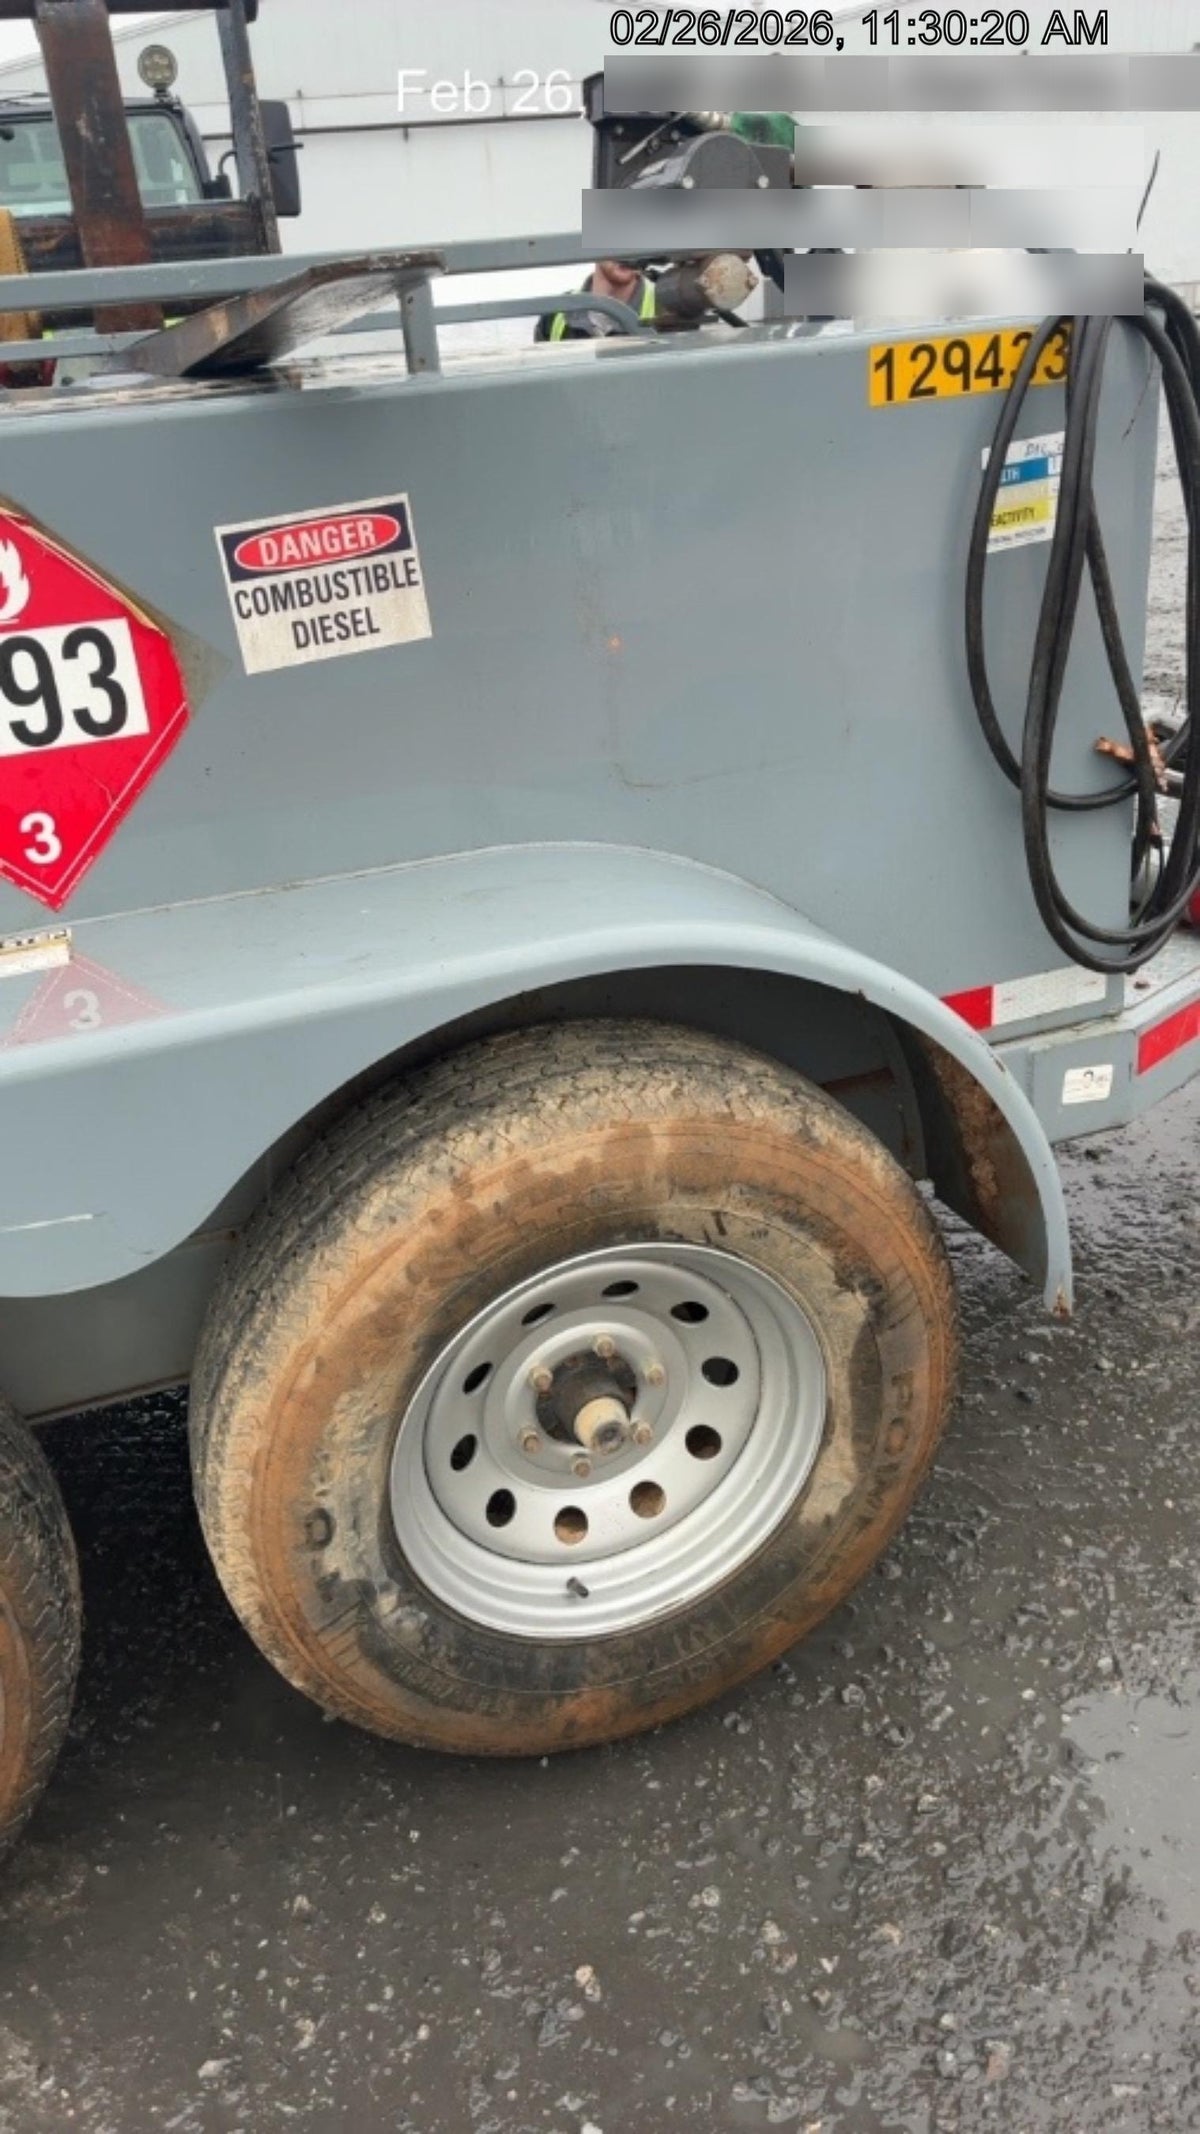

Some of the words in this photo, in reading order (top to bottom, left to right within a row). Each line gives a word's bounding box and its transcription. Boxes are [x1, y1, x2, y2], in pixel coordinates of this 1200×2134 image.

[991, 506, 1035, 527] EACTIVITY
[258, 518, 377, 567] DANGER
[233, 557, 420, 620] COMBUSTIBLE
[291, 606, 381, 650] DIESEL
[18, 810, 63, 865] 3
[62, 988, 103, 1031] 3
